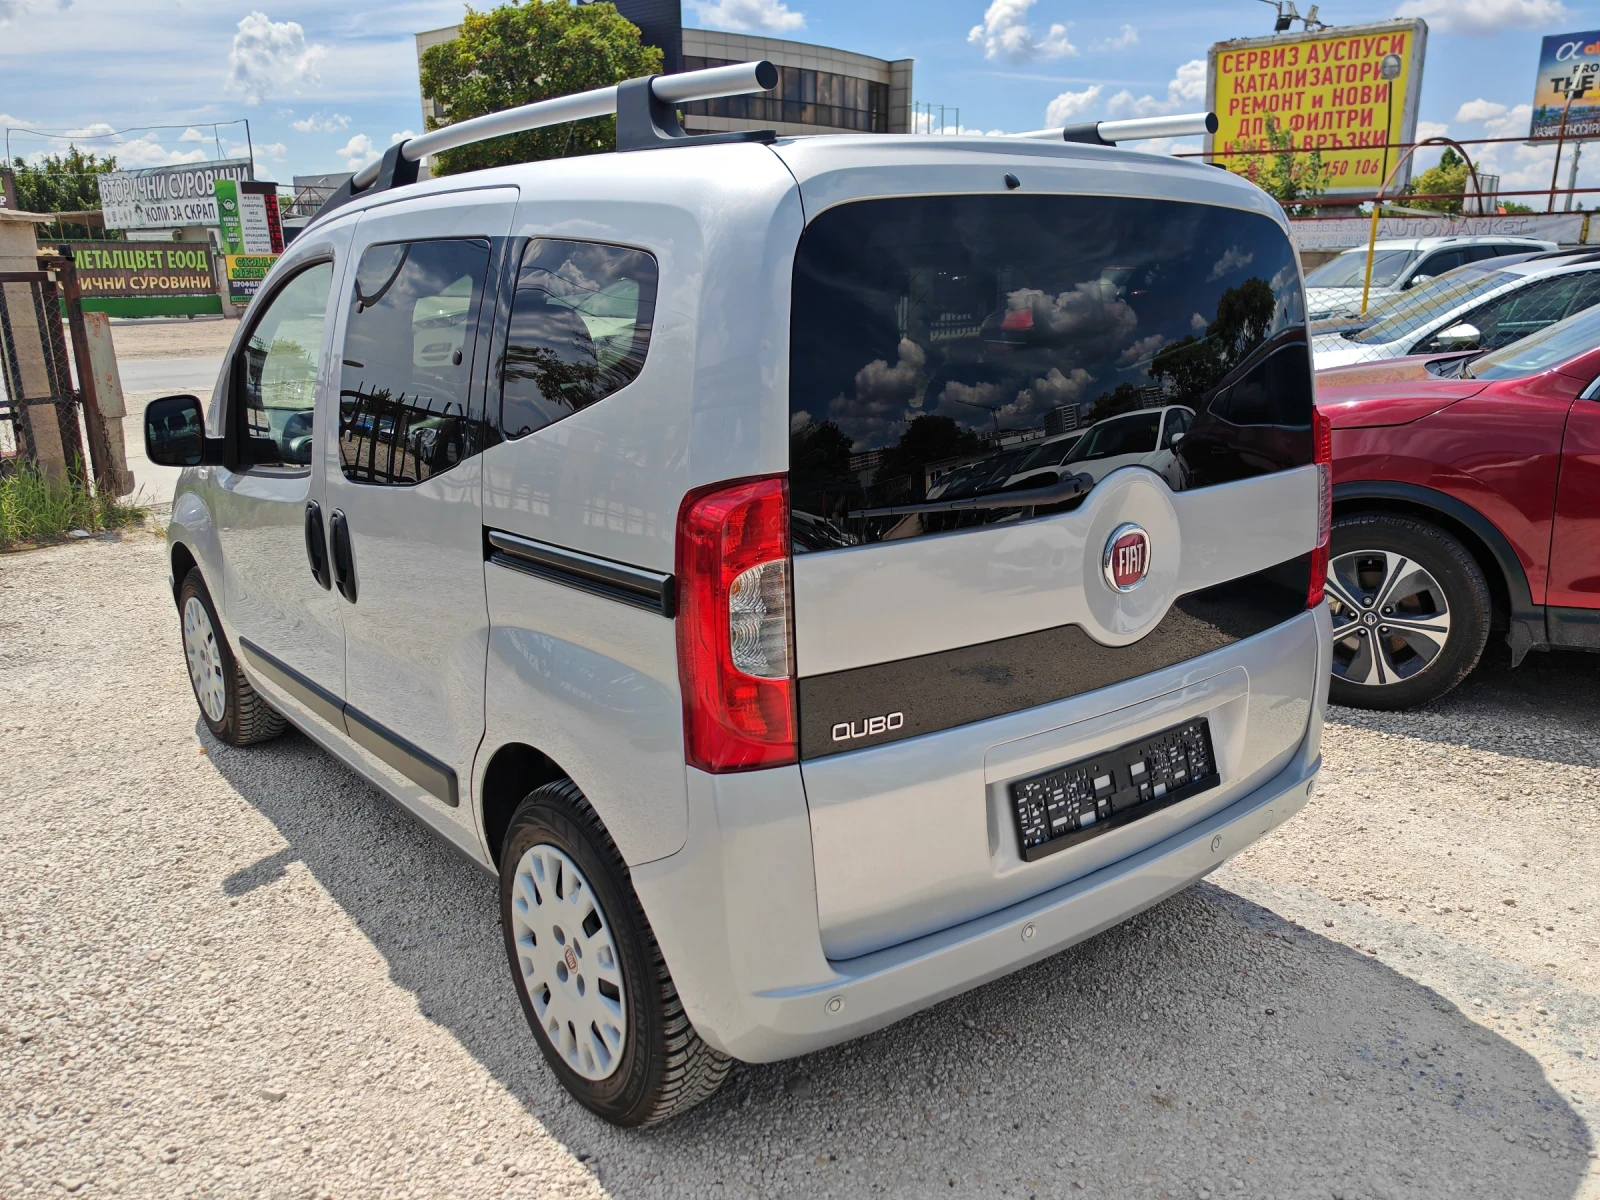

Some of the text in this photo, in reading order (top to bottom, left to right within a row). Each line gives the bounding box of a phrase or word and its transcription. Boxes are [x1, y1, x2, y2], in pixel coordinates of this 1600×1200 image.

[1222, 34, 1406, 74] СЕРВИЗ АУСПУСИ
[1233, 61, 1384, 95] КАТАЛИЗАТОРИ
[1550, 75, 1595, 93] THE
[1229, 91, 1305, 117] РЕМОНТ
[1332, 83, 1388, 107] НОВИ
[1289, 108, 1374, 132] ФИЛТРИ
[1302, 130, 1387, 153] ВРЪЗКИ
[1325, 160, 1348, 176] 150
[1354, 158, 1379, 175] 106
[102, 174, 167, 203] ВТОРИЧНИ
[145, 203, 216, 223] КОЛИ ЗА СКРАП
[1376, 217, 1529, 237] AUTOMARKET
[72, 250, 209, 272] МЕТАЛЦВЕТ ЕООД
[129, 275, 211, 290] СУРОВИНИ
[232, 268, 268, 278] МЕТА
[1118, 542, 1145, 577] FIAT
[832, 711, 904, 742] QUBO
